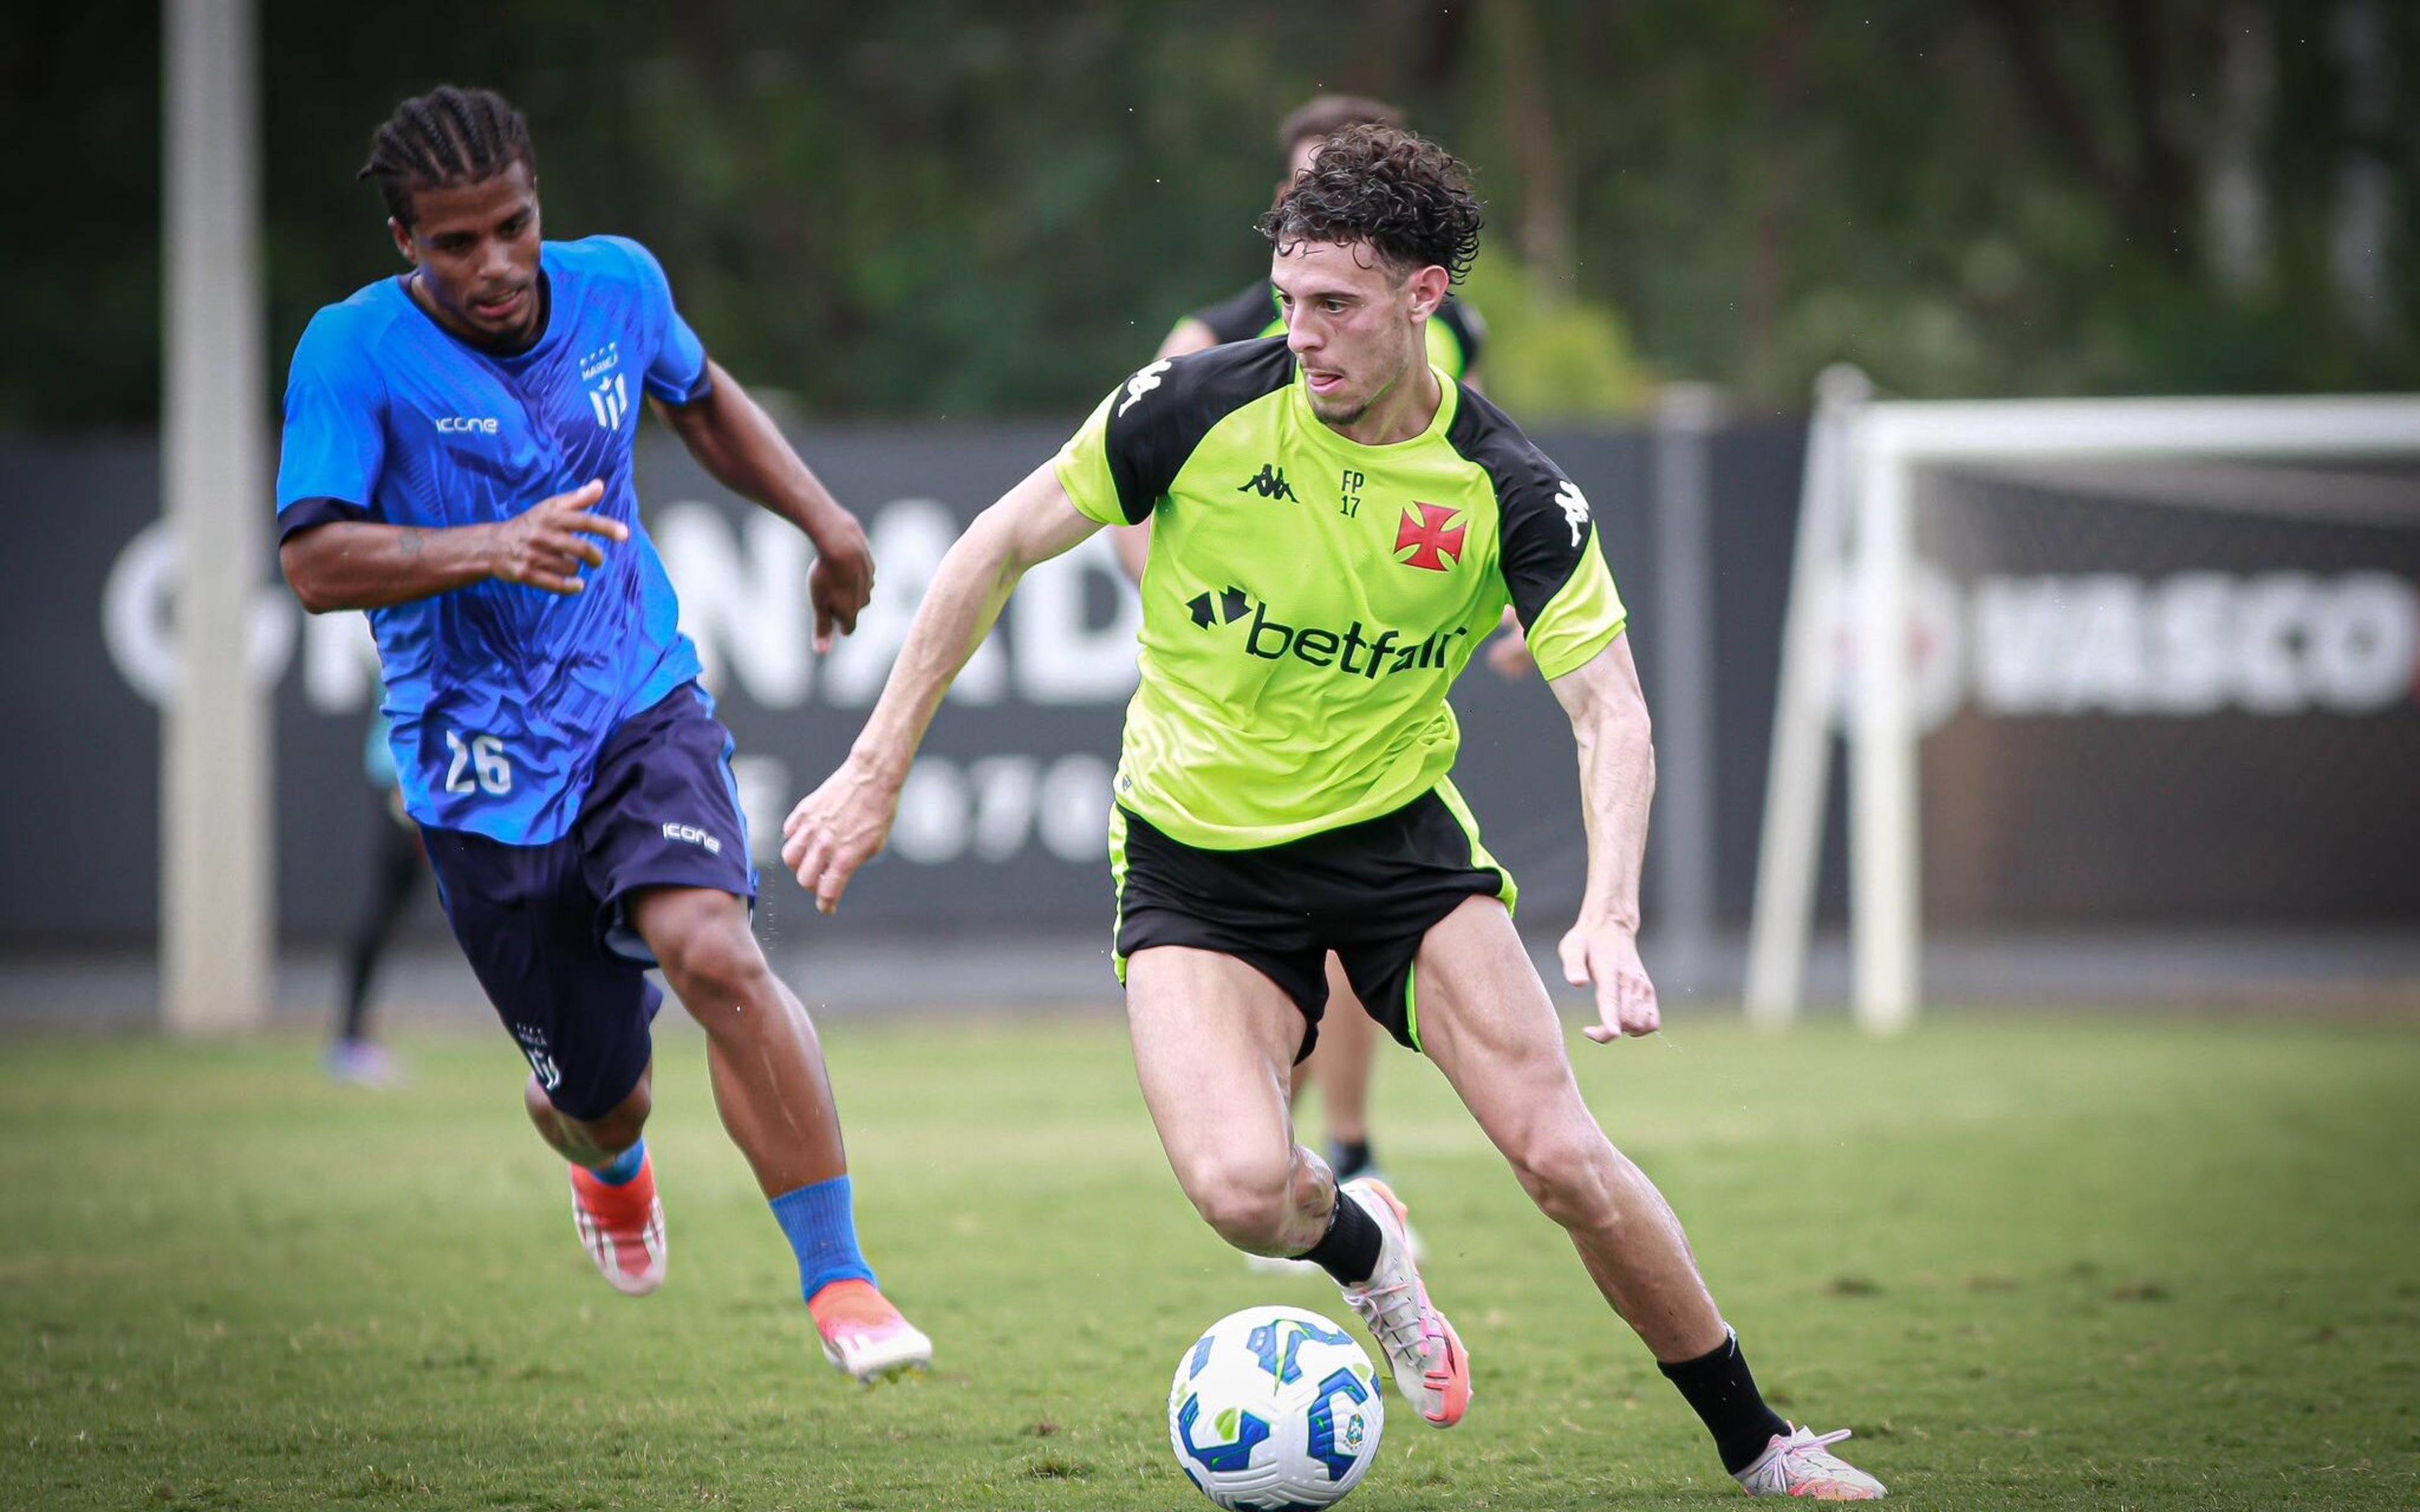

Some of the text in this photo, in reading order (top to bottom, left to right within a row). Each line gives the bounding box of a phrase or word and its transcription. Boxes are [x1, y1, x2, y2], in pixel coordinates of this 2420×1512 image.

[1339, 495, 1361, 518] 17
[1340, 469, 1365, 494] FP
[1244, 600, 1468, 680] betfair
[1971, 570, 2412, 716] VASCO
[445, 729, 512, 795] 26
